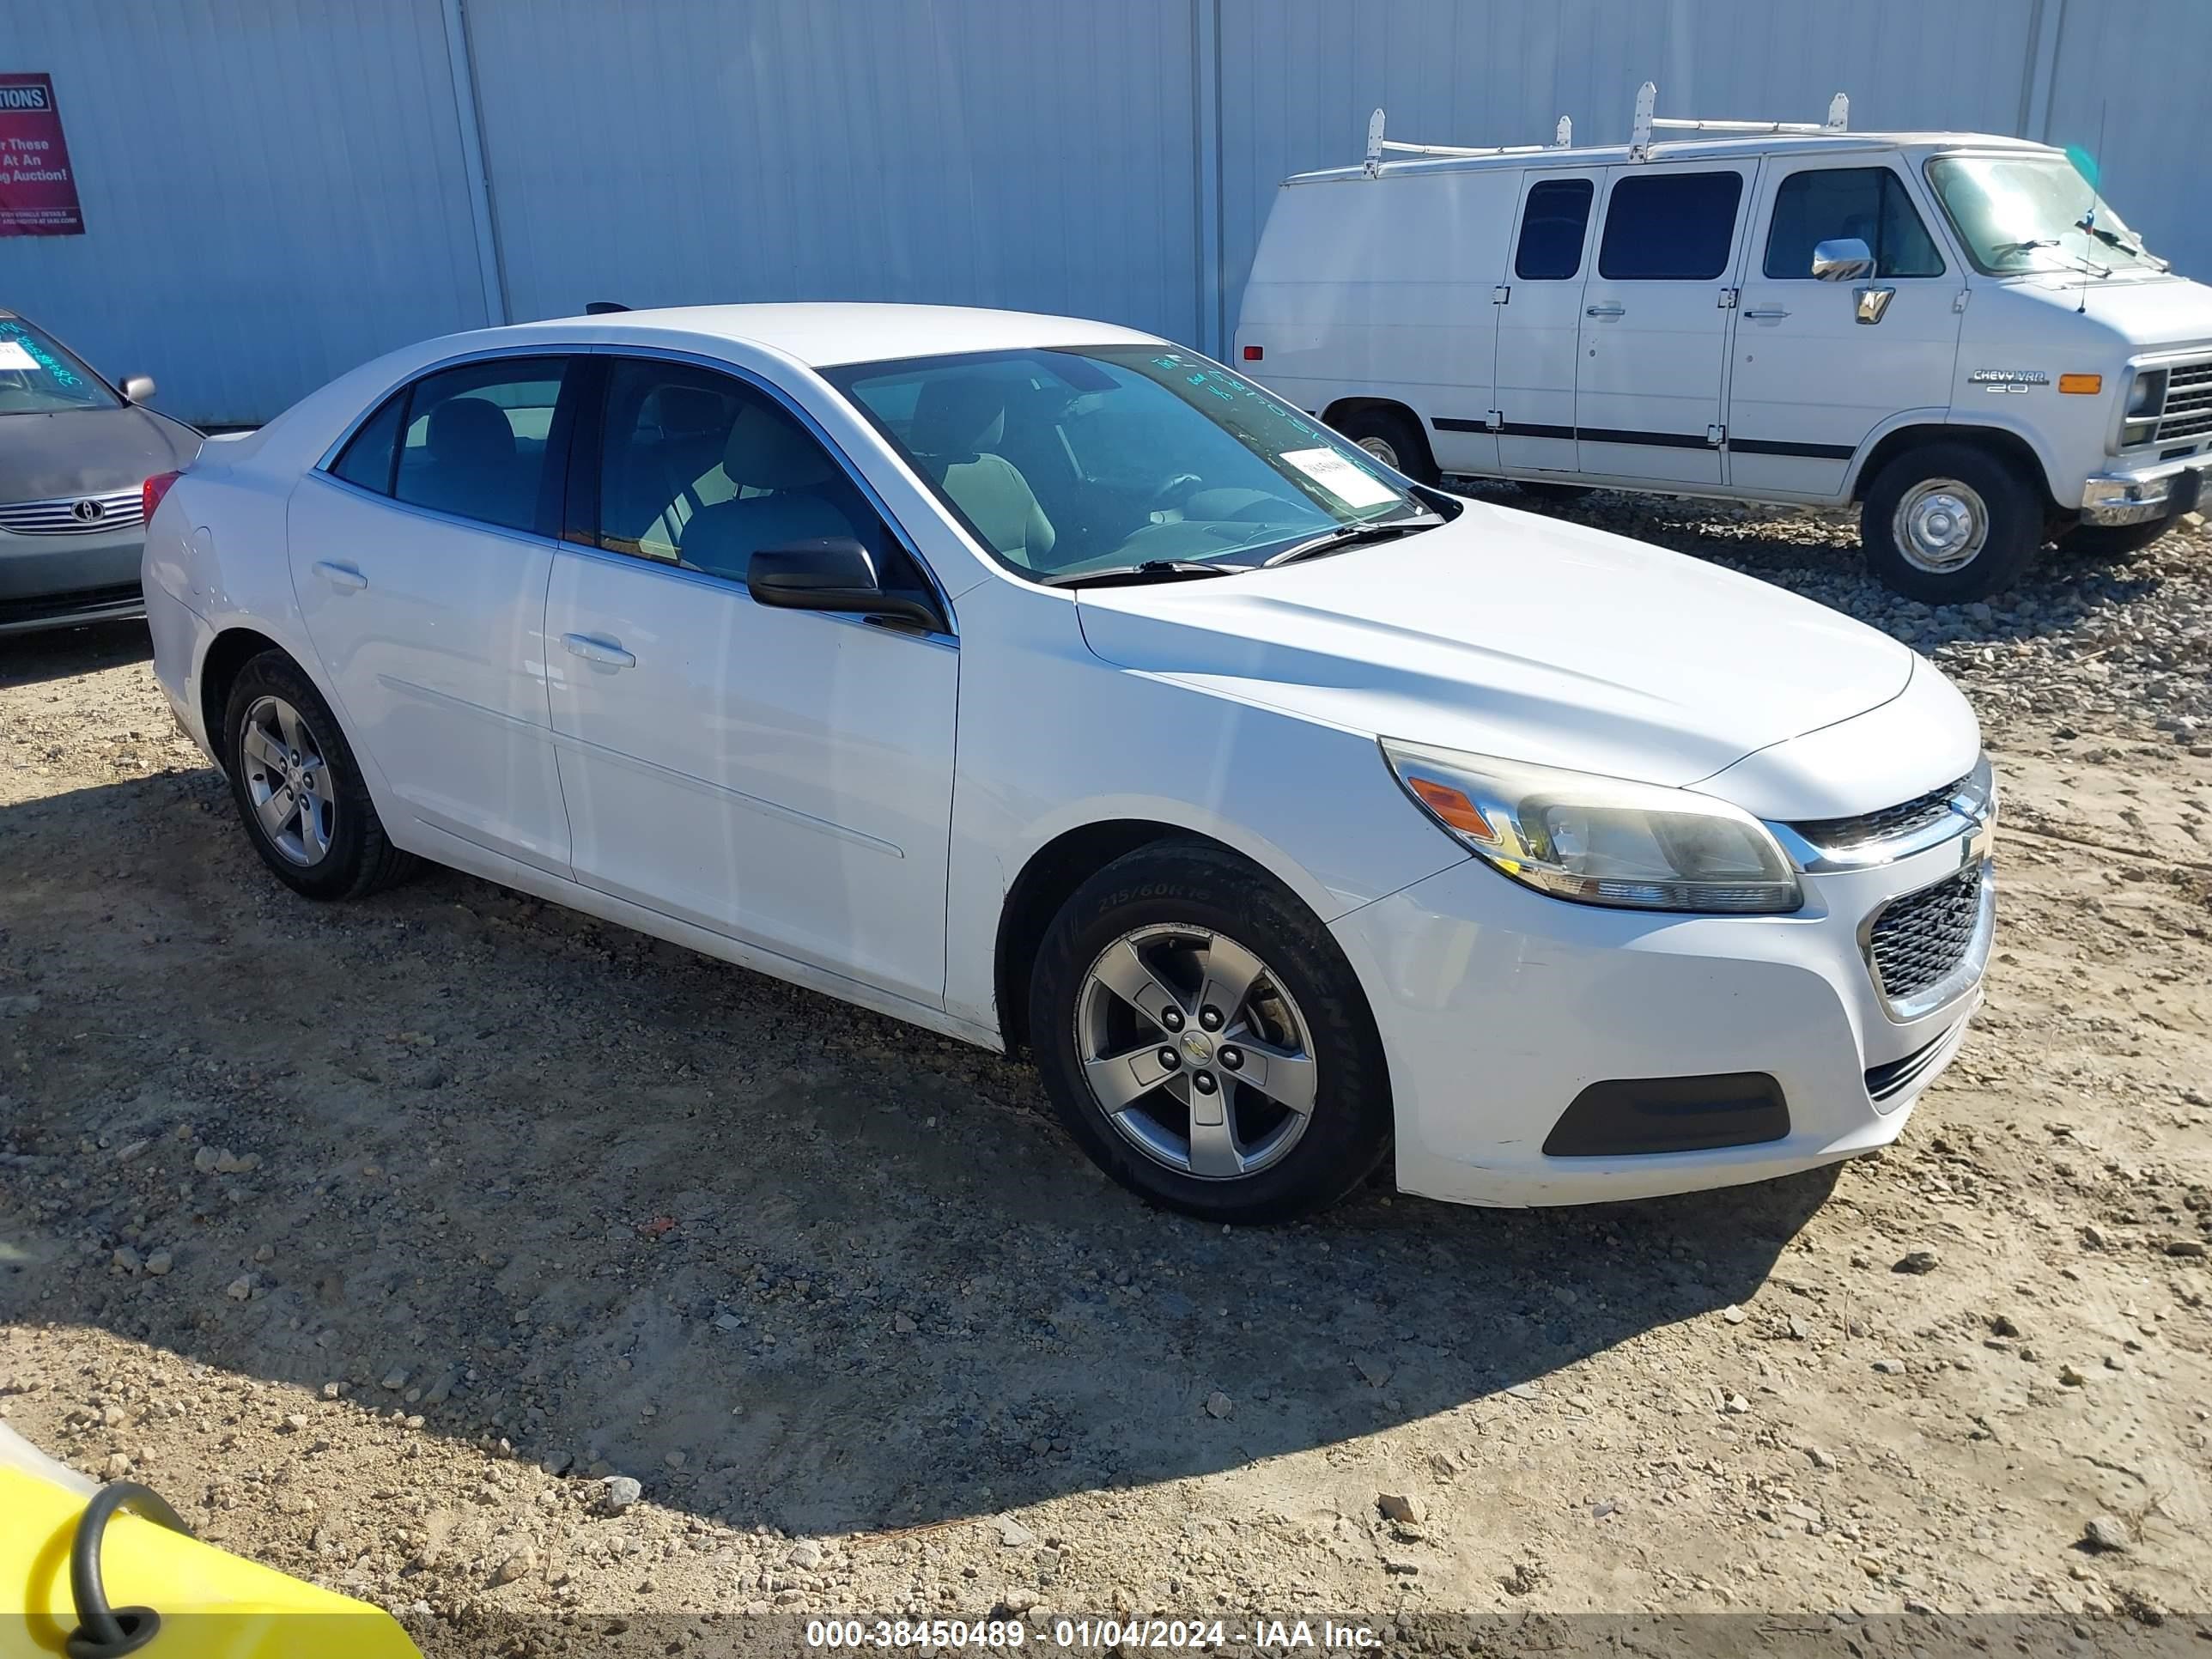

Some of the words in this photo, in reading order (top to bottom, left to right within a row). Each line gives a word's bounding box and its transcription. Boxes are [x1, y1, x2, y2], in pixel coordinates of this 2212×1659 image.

[8, 138, 49, 150] These
[3, 155, 19, 166] At
[23, 155, 41, 166] An
[14, 168, 68, 182] Auction!
[1973, 370, 2014, 380] CHEVY
[2017, 370, 2045, 381] VAN
[1986, 383, 2029, 393] 20
